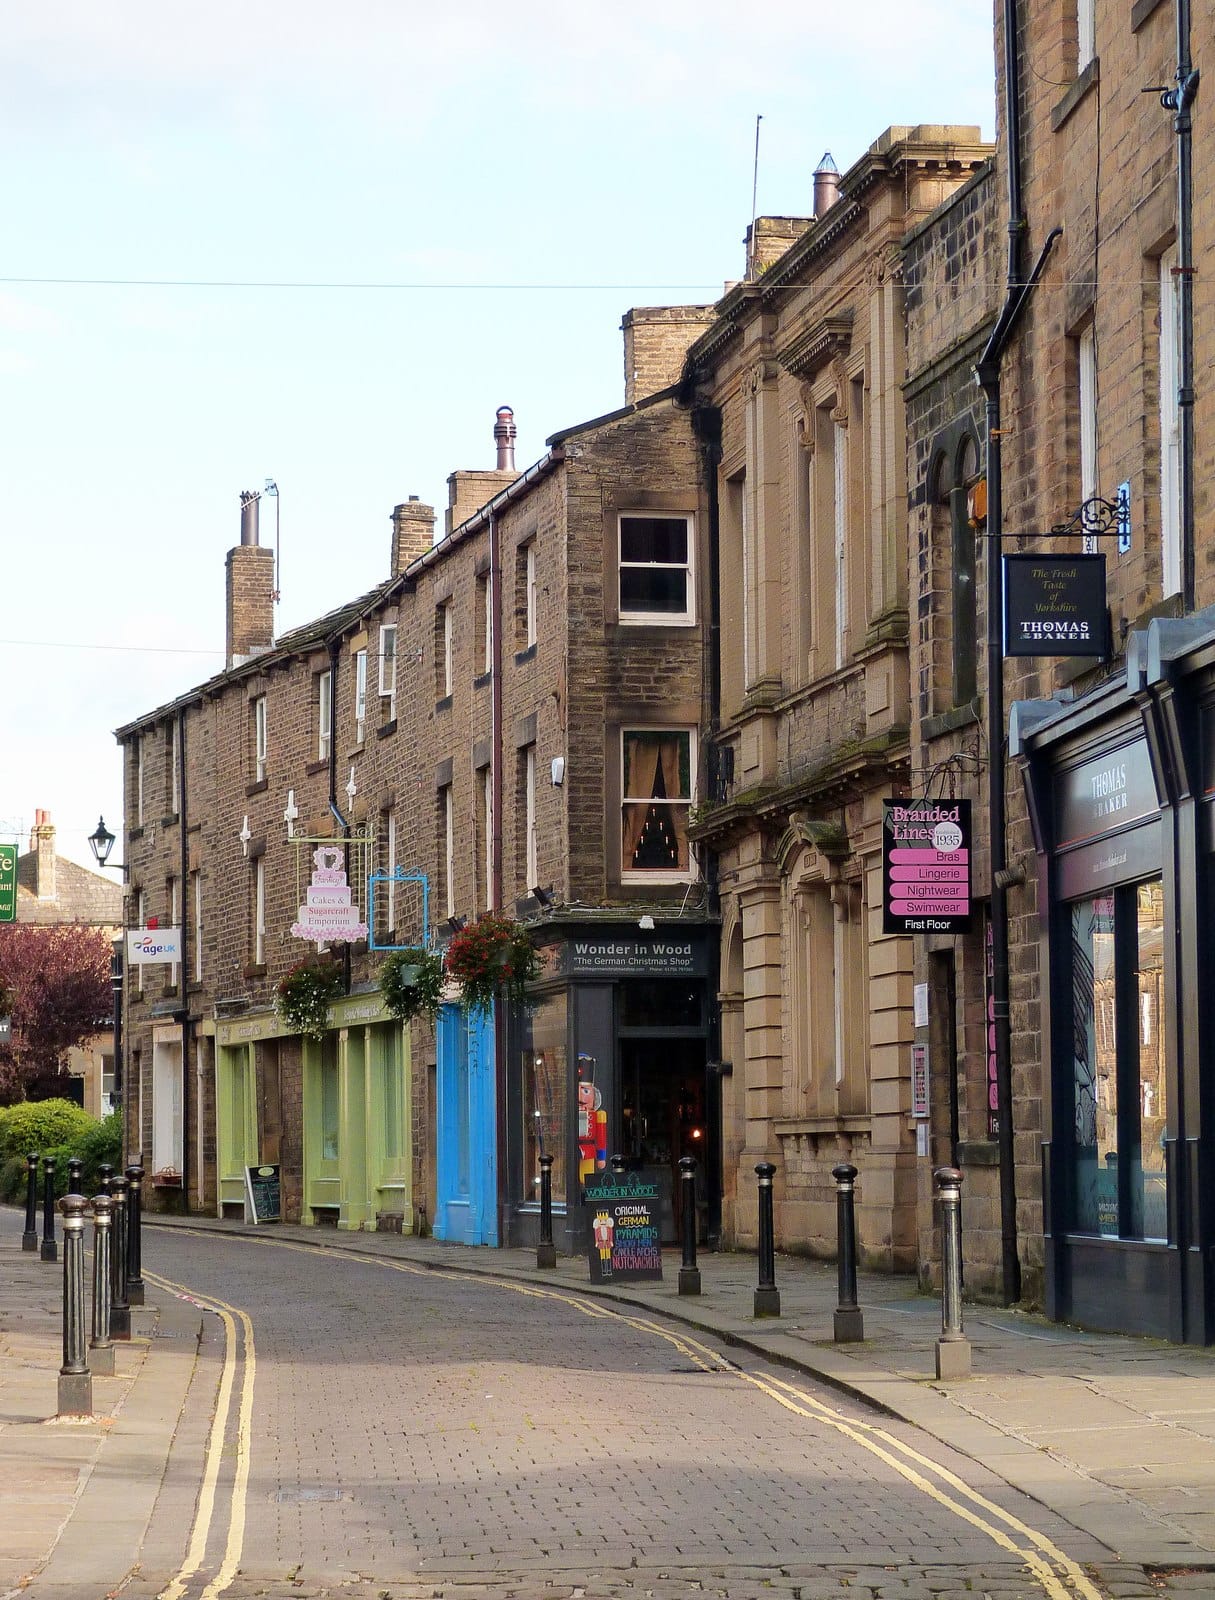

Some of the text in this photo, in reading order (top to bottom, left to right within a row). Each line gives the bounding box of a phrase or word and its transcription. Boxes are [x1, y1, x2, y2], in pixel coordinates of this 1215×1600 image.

[1031, 568, 1077, 578] The Fresh
[1042, 580, 1066, 590] Taste
[1049, 591, 1059, 602] of
[1034, 602, 1077, 614] Yorkshire
[1020, 622, 1089, 632] THOMAS
[1033, 632, 1091, 640] BAKER
[1091, 764, 1127, 799] THOMAS
[1098, 793, 1129, 817] BAKER
[892, 805, 961, 823] Branded
[892, 824, 935, 840] Lines
[935, 835, 960, 846] 1935
[936, 852, 960, 862] Bras
[919, 868, 960, 880] Lingerie
[907, 885, 961, 897] Nightwear
[312, 896, 345, 905] Cakes &
[308, 907, 349, 917] Sugarcraft
[906, 902, 961, 913] Swimwear
[308, 918, 350, 927] Emporium
[905, 919, 951, 929] First Floor
[575, 943, 692, 955] Wonder in Wood
[574, 957, 693, 966] "The German Christmas Shop"
[586, 1187, 619, 1197] WONDER
[629, 1187, 654, 1197] WOOD
[614, 1204, 651, 1216] ORIGINAL
[618, 1216, 650, 1226] GERMAN
[615, 1227, 658, 1240] PYRAMIDS
